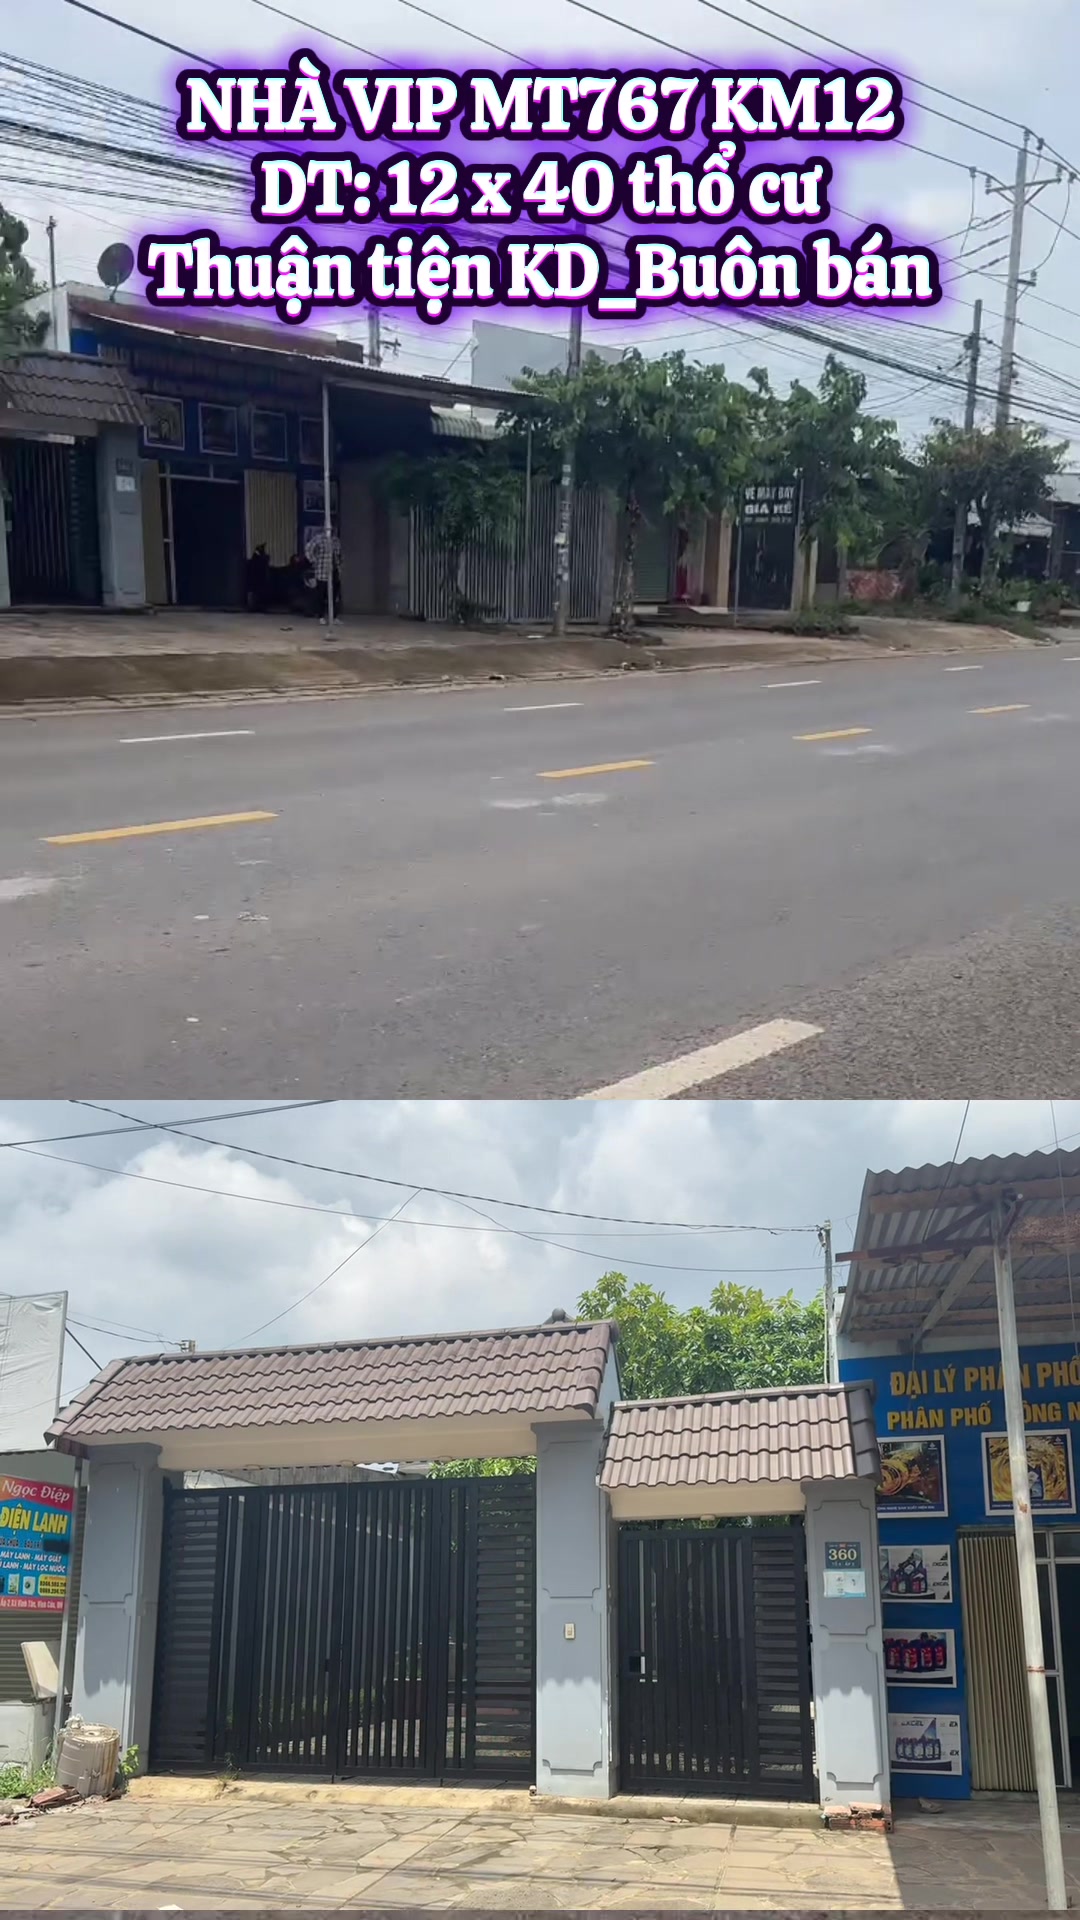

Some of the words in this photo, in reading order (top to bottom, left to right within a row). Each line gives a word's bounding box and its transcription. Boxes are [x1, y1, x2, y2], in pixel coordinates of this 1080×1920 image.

[778, 486, 795, 500] BAY
[890, 1370, 928, 1399] ĐẠI
[934, 1363, 956, 1393] LÝ
[964, 1363, 1031, 1392] PHN
[888, 1406, 944, 1430] PHÂN
[951, 1400, 992, 1427] PHỐ
[2, 1480, 38, 1498] Ngọc
[40, 1485, 70, 1503] Điệp
[0, 1503, 31, 1535] ĐIỆN
[32, 1511, 68, 1538] LẠNH
[828, 1548, 857, 1561] 360
